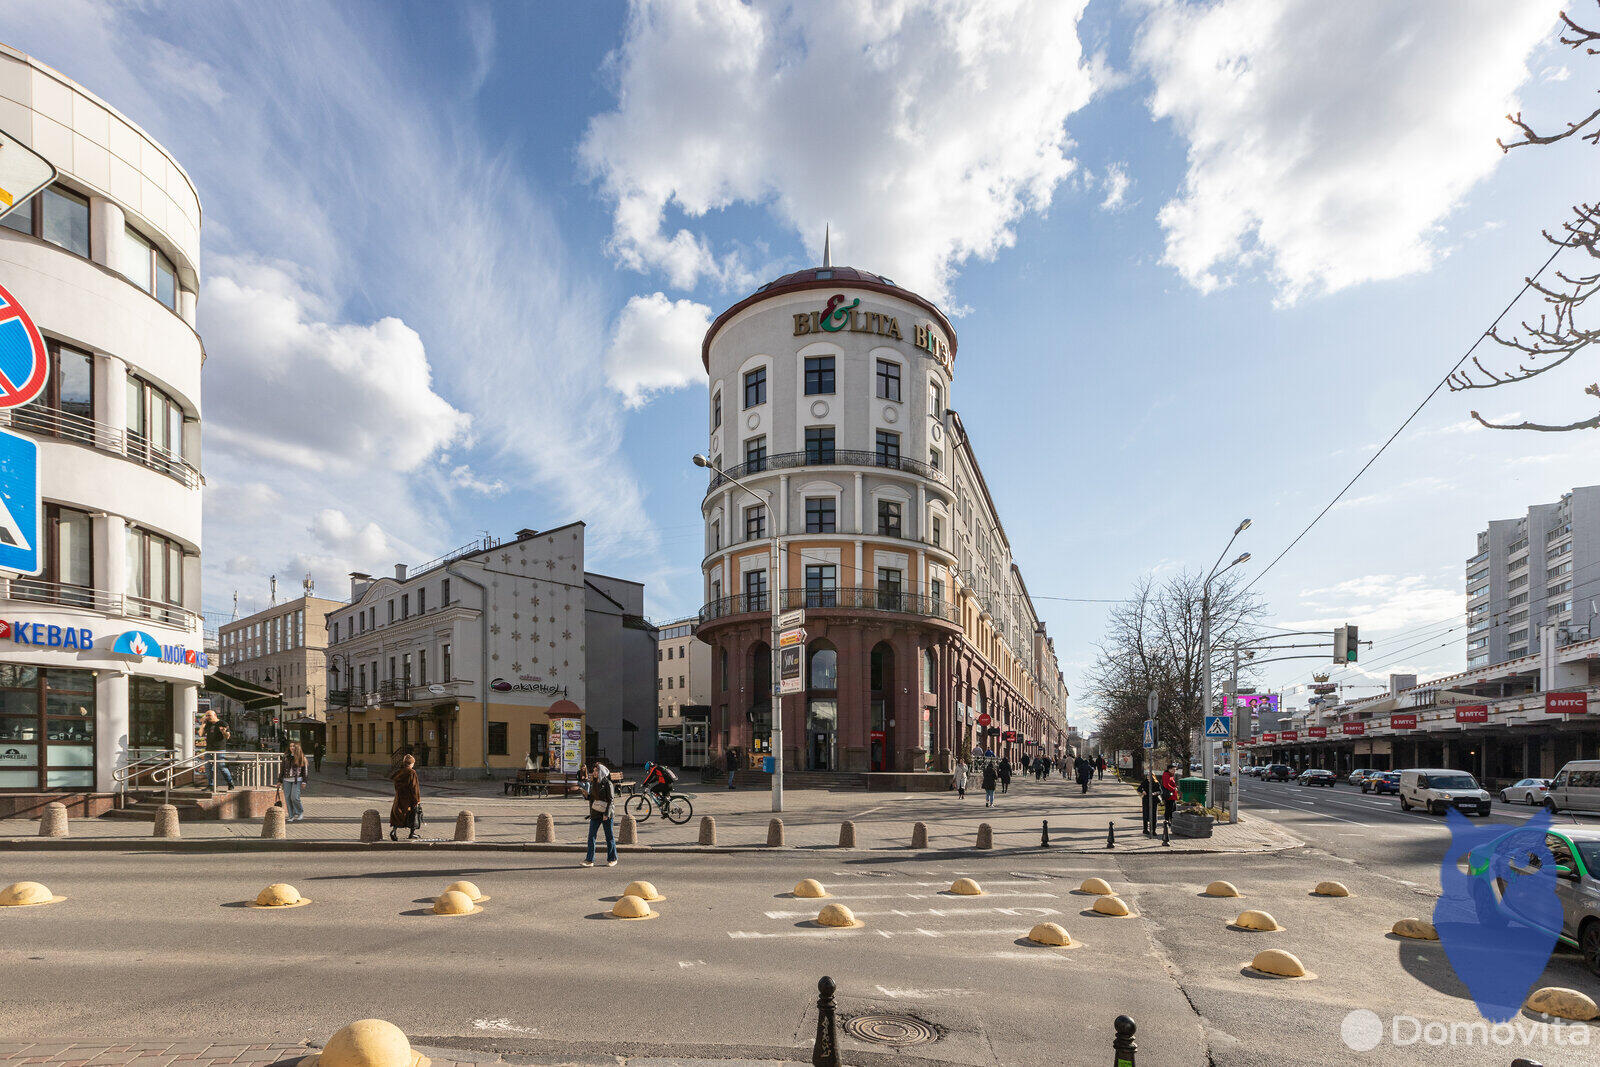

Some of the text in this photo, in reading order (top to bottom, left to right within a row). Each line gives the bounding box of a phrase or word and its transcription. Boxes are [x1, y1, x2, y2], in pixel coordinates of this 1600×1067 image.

[14, 621, 93, 650] KEBAB
[164, 644, 187, 664] МОЙ
[1557, 699, 1584, 707] МТС
